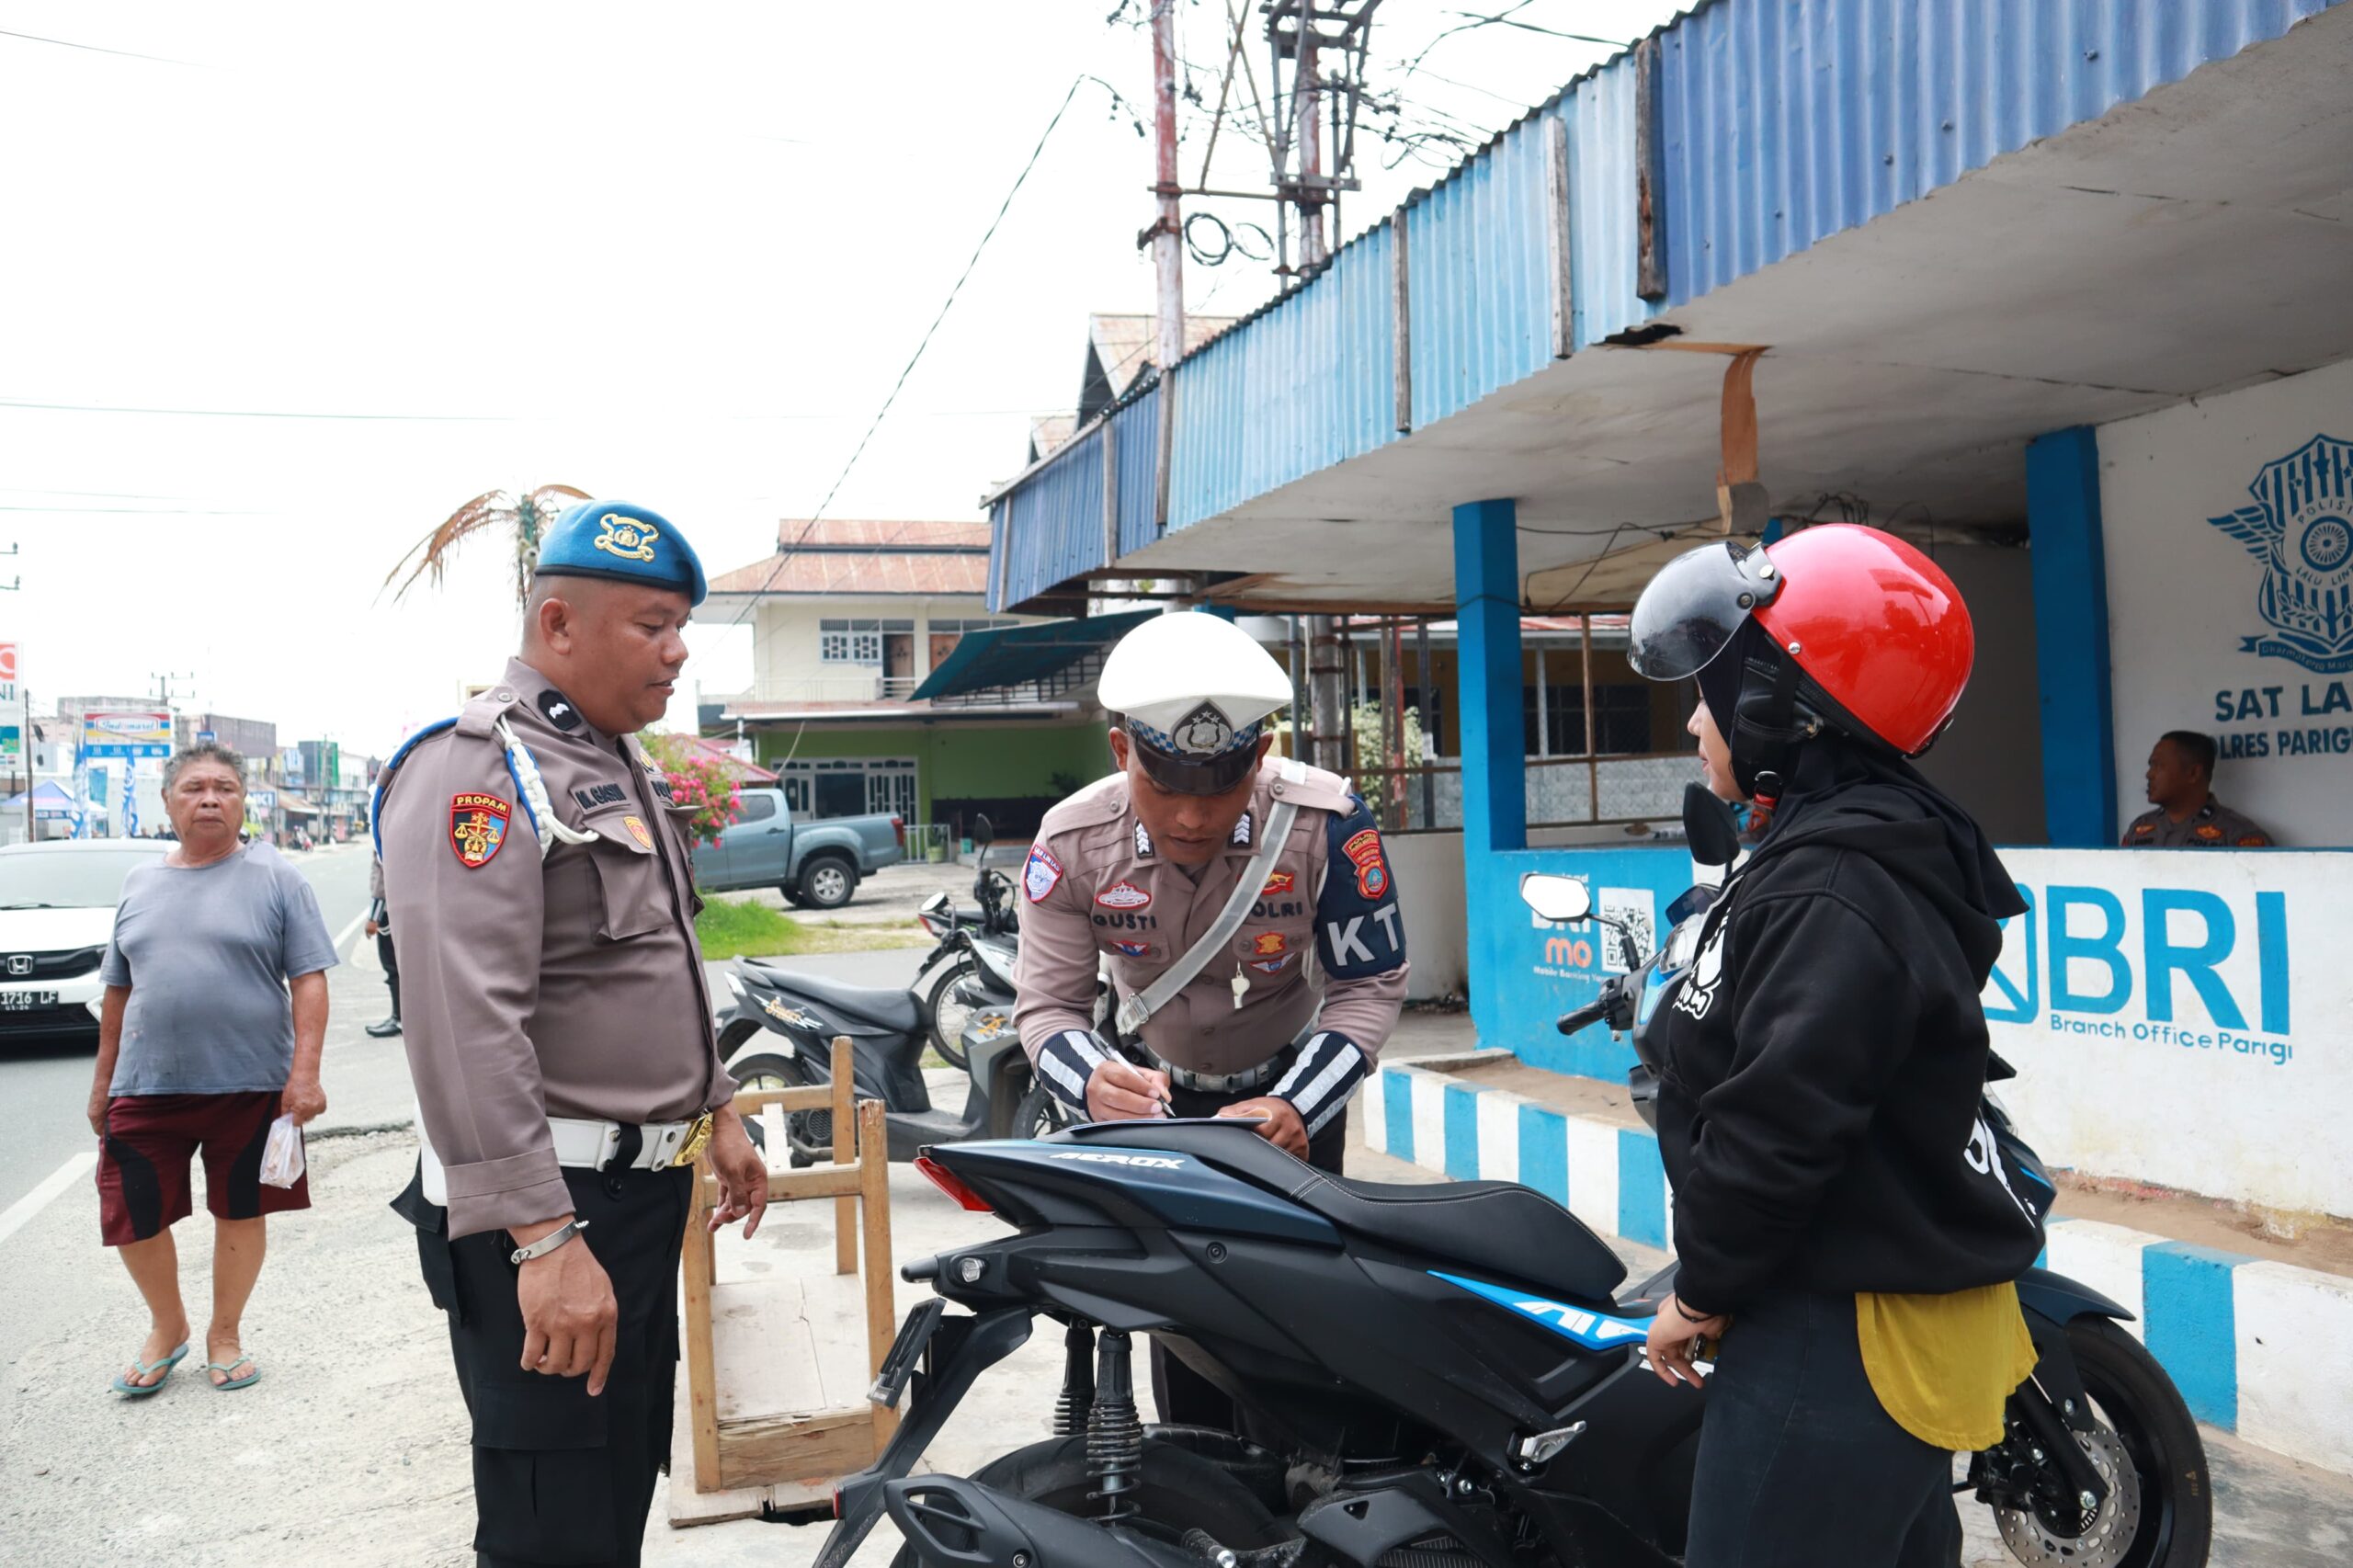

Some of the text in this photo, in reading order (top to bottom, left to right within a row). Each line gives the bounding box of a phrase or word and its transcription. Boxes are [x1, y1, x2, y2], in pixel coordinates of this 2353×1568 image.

[2215, 681, 2353, 722] SAT LA
[2220, 727, 2353, 759] LRES PARIG
[457, 795, 506, 812] PROPAM
[1092, 913, 1158, 930] GUSTI
[1251, 901, 1302, 918] OLRI
[1327, 903, 1399, 967] KT
[1546, 937, 1592, 968] mo
[2046, 885, 2290, 1035] BRI
[40, 991, 56, 1005] LF
[2051, 1014, 2293, 1065] Branch Office Parigi
[1050, 1153, 1186, 1170] AEROX
